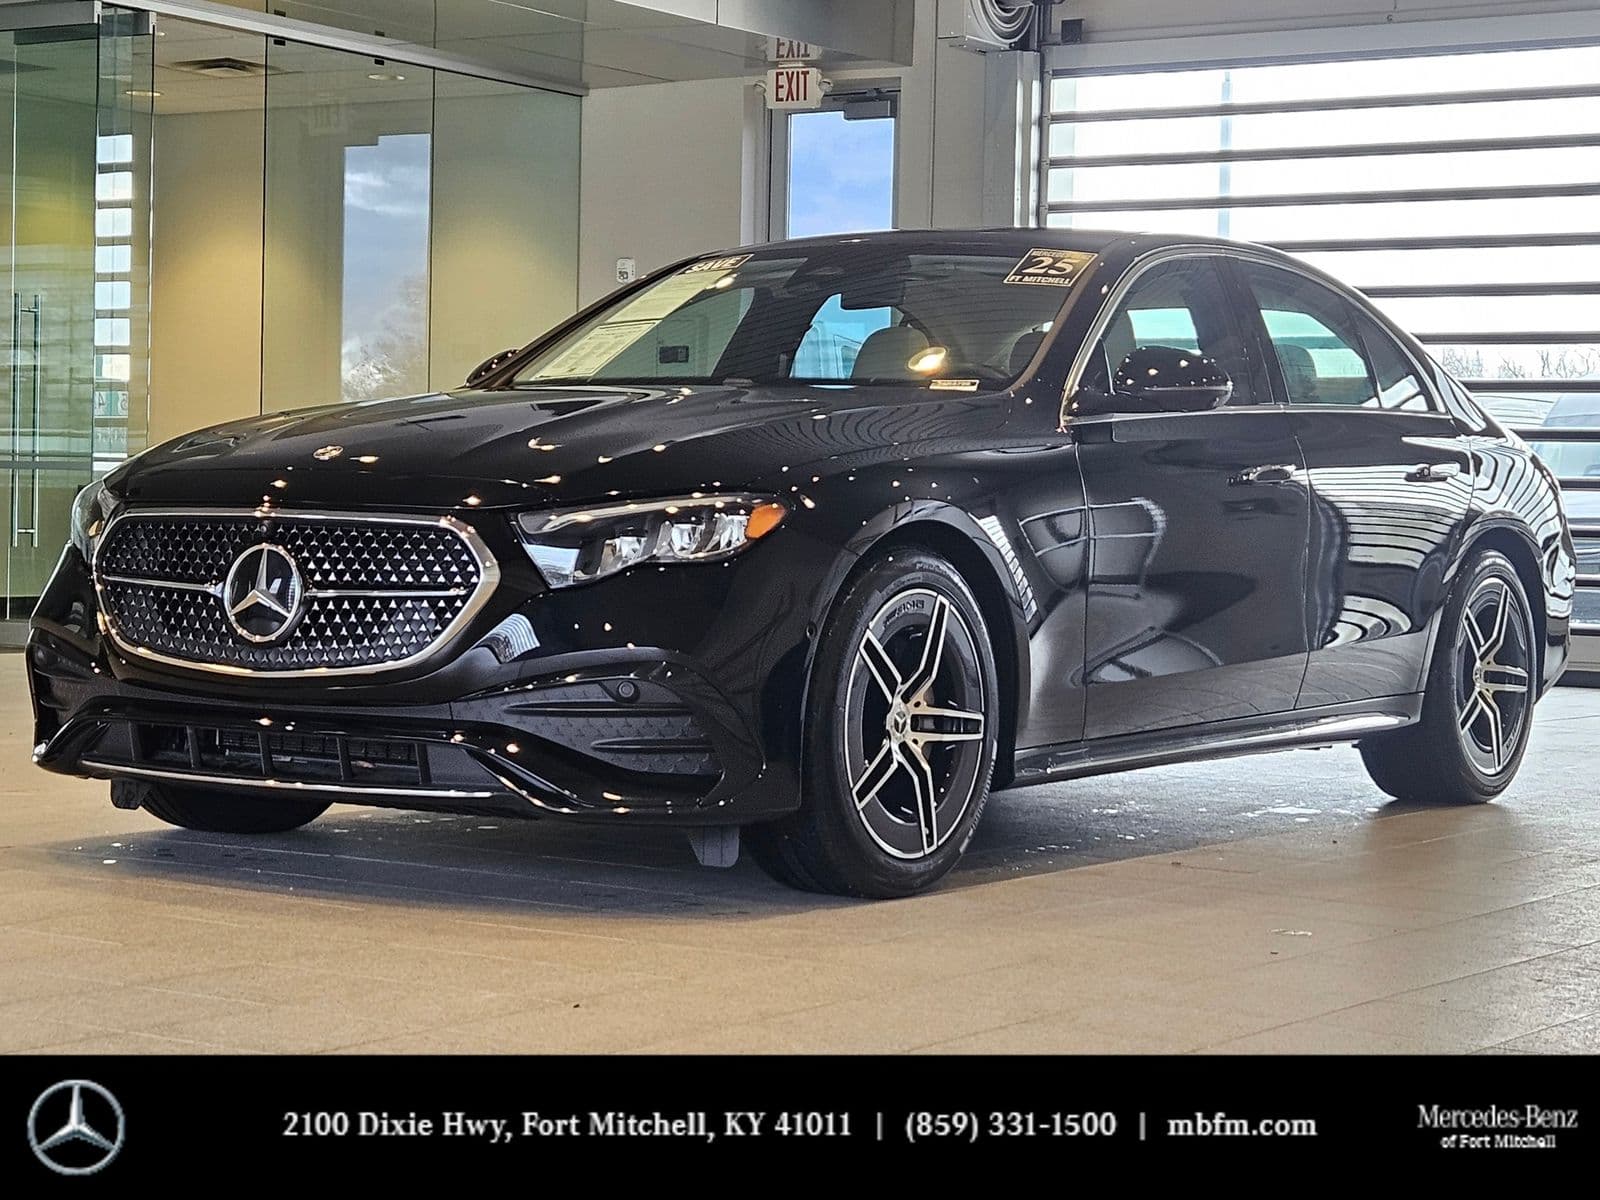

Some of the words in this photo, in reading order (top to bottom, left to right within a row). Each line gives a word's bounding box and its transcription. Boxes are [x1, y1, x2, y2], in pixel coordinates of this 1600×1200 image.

[775, 71, 810, 102] EXIT
[1021, 257, 1080, 274] 25
[1023, 276, 1070, 284] MITCHELL
